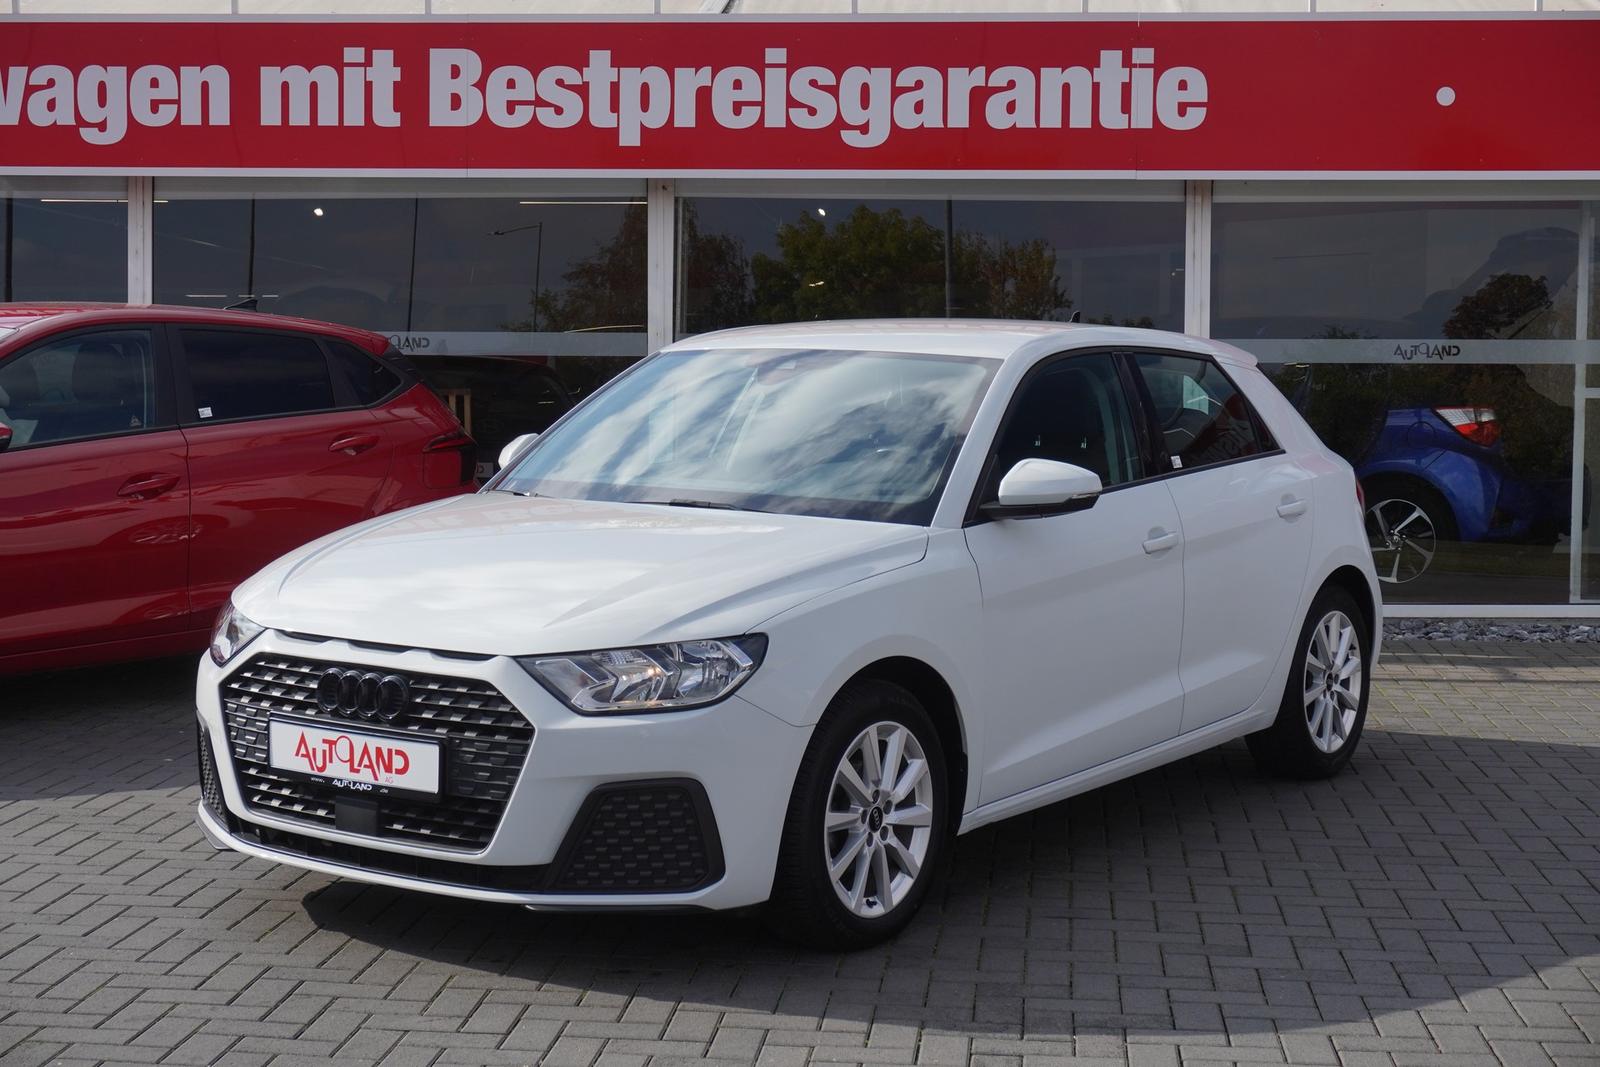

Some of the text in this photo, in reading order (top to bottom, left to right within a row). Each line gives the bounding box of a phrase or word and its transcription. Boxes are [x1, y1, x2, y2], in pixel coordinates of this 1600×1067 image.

[260, 47, 401, 128] mit
[429, 47, 1209, 149] Bestpreisgarantie
[1393, 342, 1461, 361] AUTOLAND
[295, 730, 410, 781] AUTOLAND
